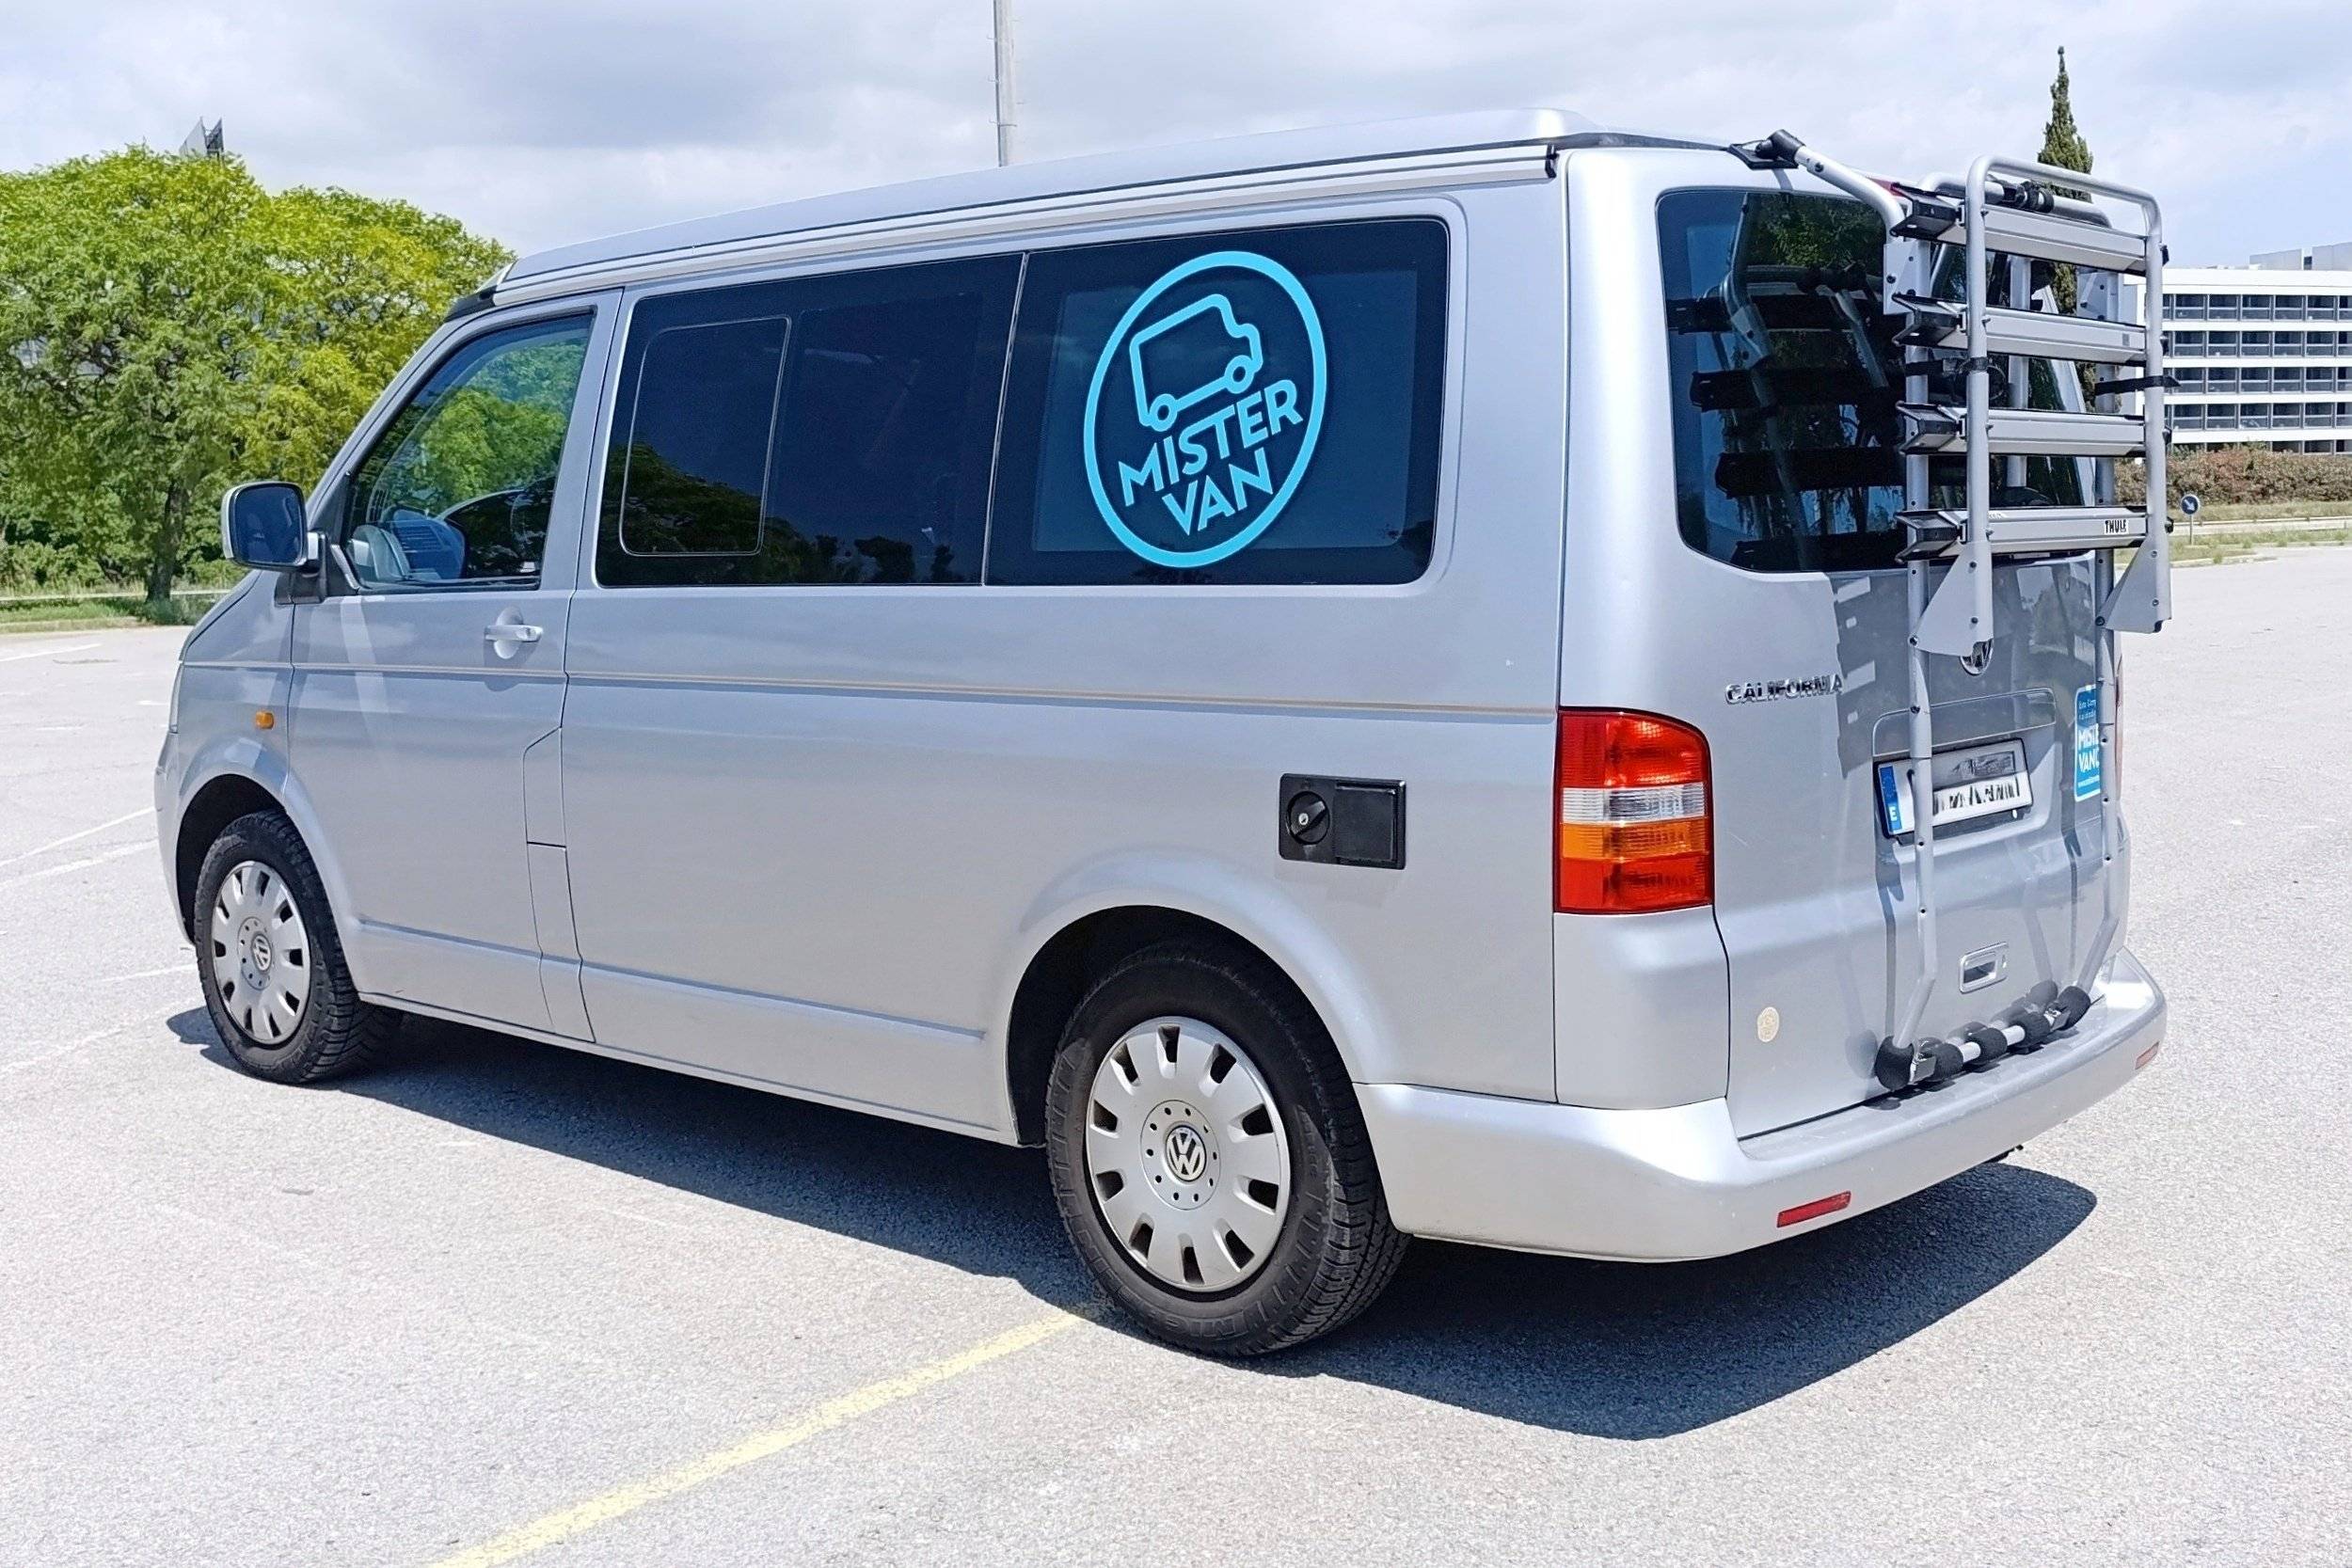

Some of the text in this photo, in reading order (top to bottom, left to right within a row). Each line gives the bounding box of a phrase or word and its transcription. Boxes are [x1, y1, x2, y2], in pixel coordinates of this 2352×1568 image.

[1118, 379, 1304, 507] MISTER
[1162, 447, 1274, 536] VAN
[1725, 673, 1844, 705] CALIFORNIA
[1888, 805, 1898, 822] E
